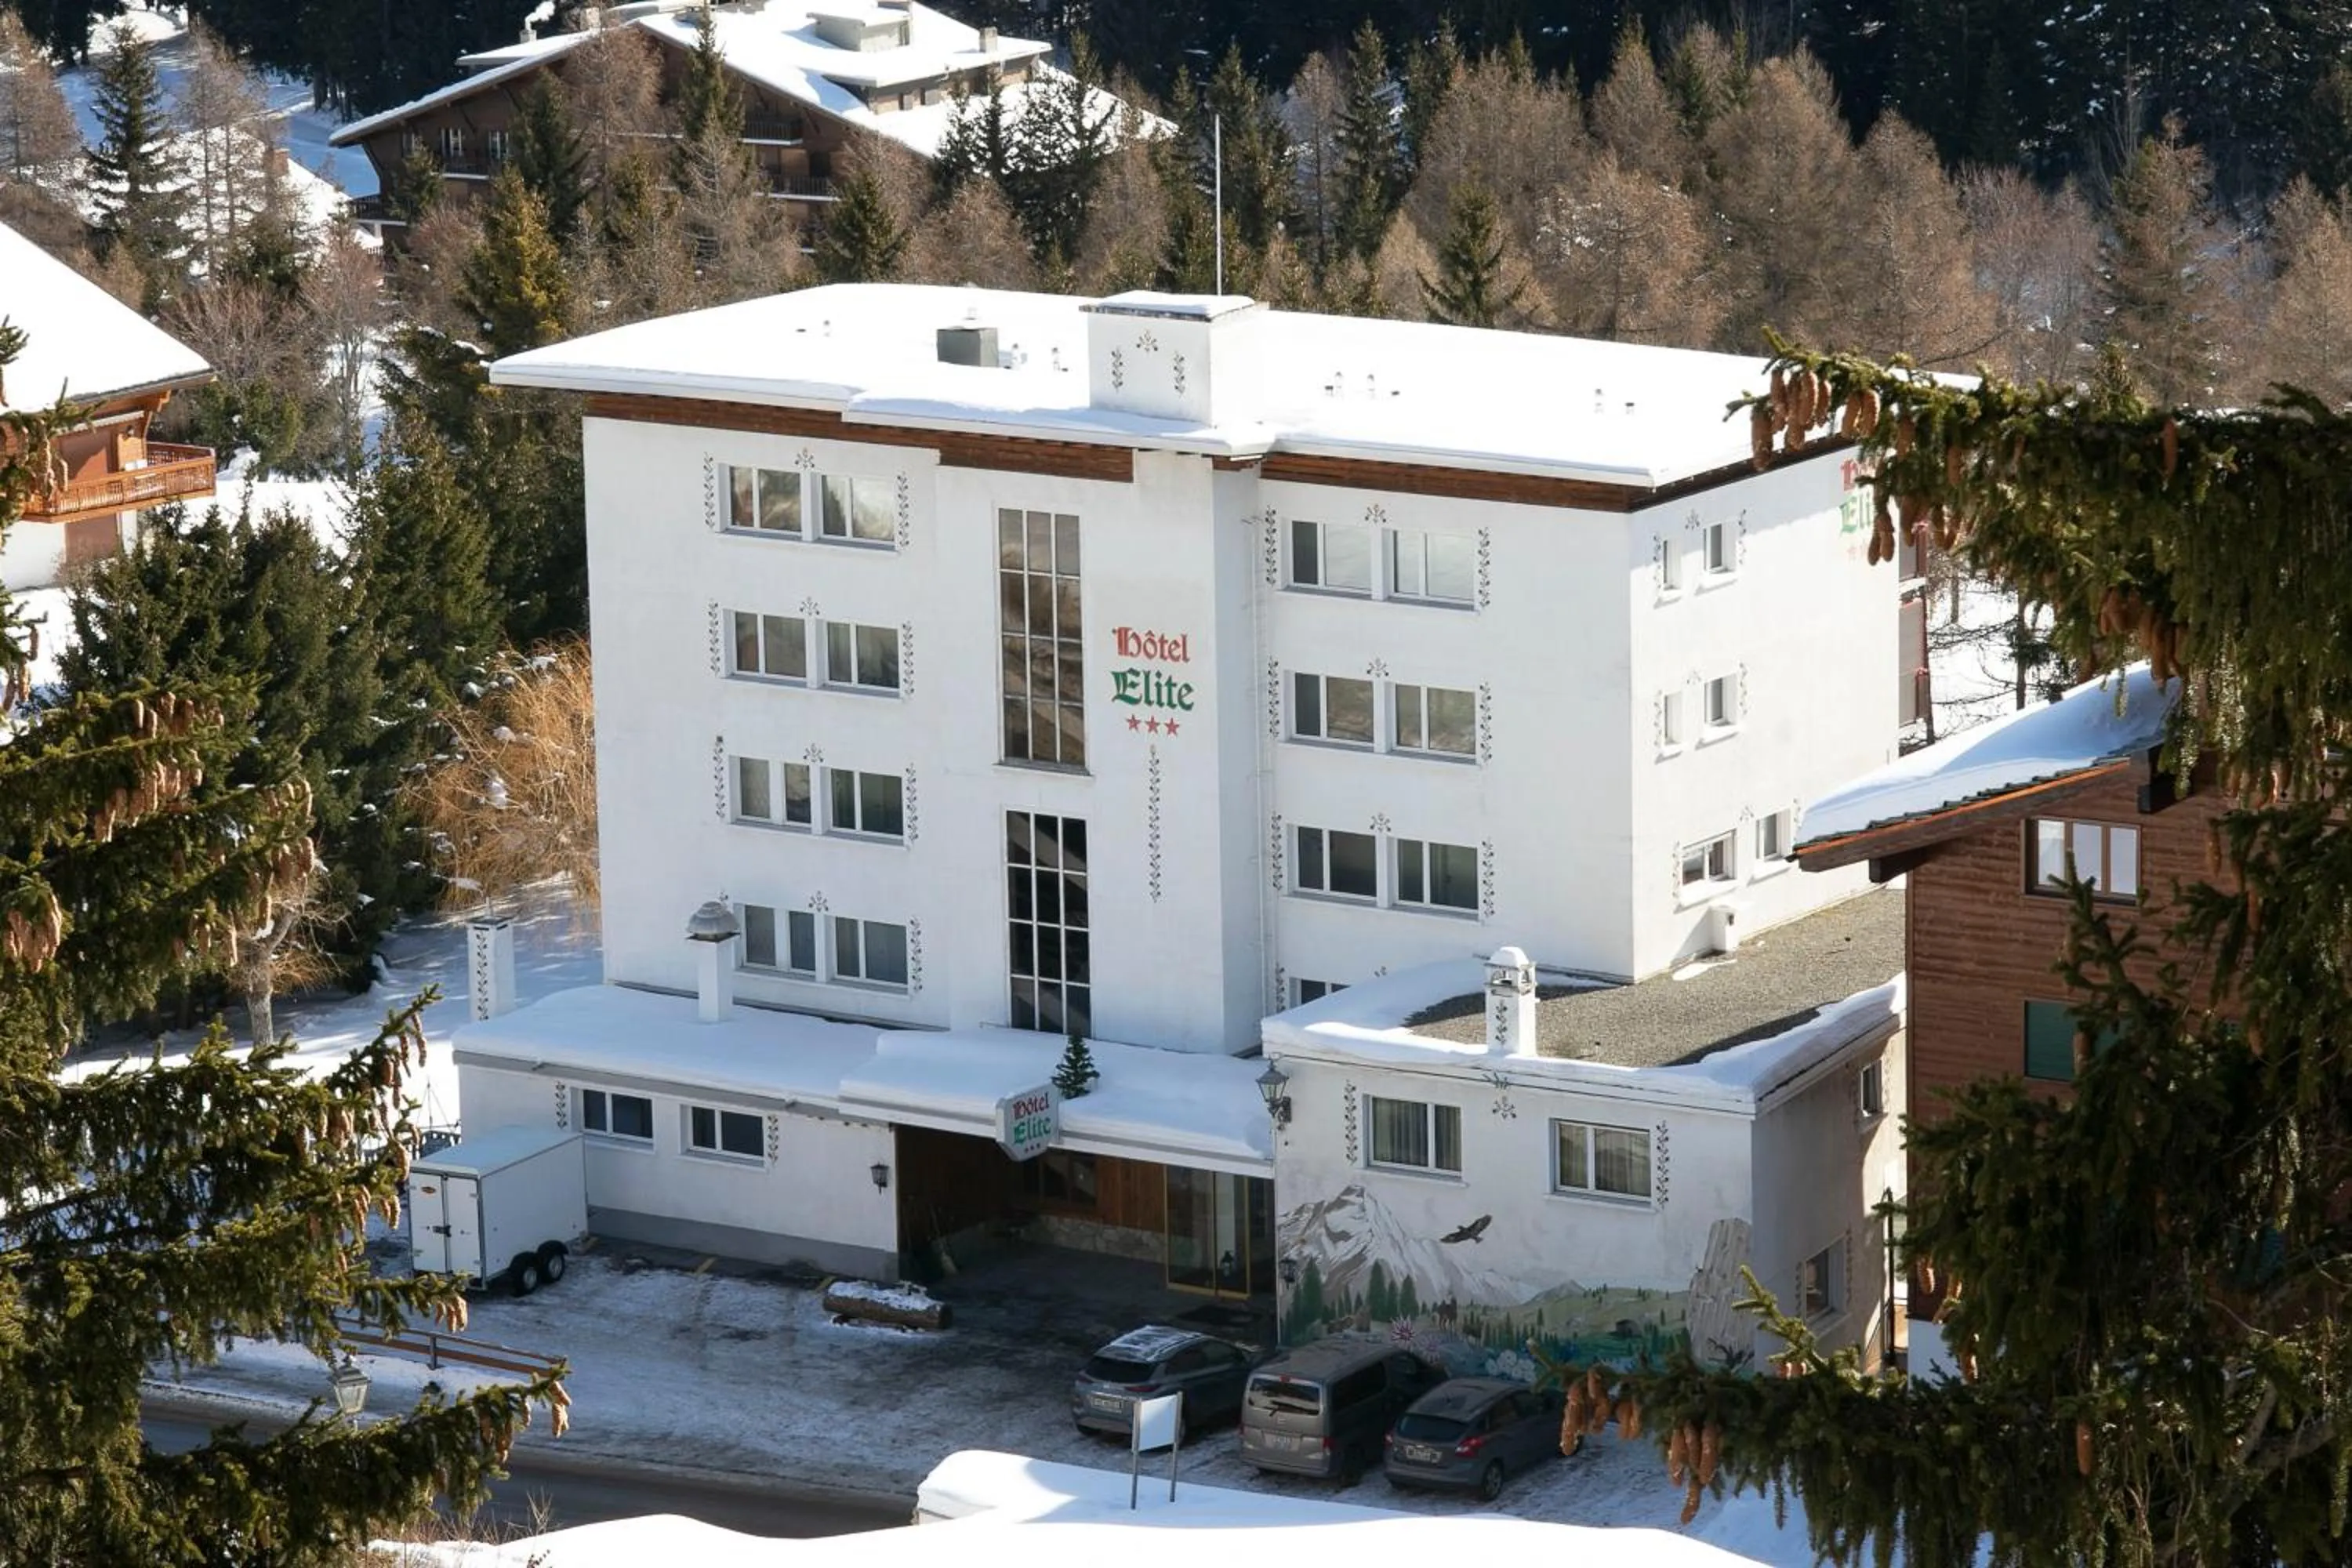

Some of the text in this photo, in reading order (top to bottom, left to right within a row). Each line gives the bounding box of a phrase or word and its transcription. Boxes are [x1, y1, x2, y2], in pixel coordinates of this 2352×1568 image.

[1839, 496, 1871, 535] Eli
[1112, 626, 1190, 662] Hôtel
[1111, 667, 1194, 711] Elite
[1014, 1116, 1051, 1144] Elite
